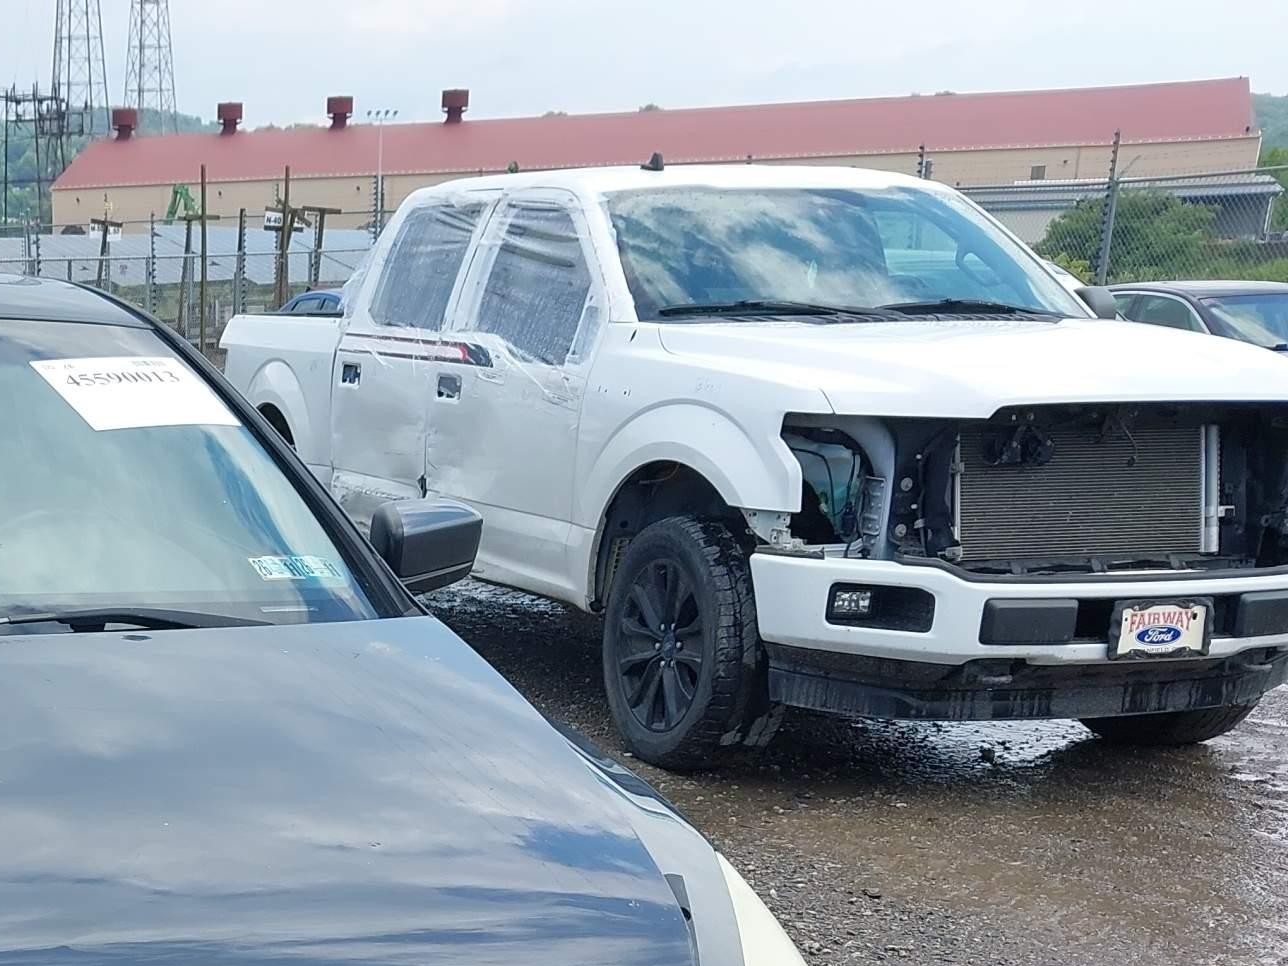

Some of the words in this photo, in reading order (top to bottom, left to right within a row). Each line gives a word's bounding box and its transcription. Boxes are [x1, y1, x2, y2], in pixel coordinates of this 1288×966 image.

[66, 370, 180, 386] 45590013
[1129, 611, 1193, 633] FAIRWAY
[1144, 627, 1174, 642] Ford
